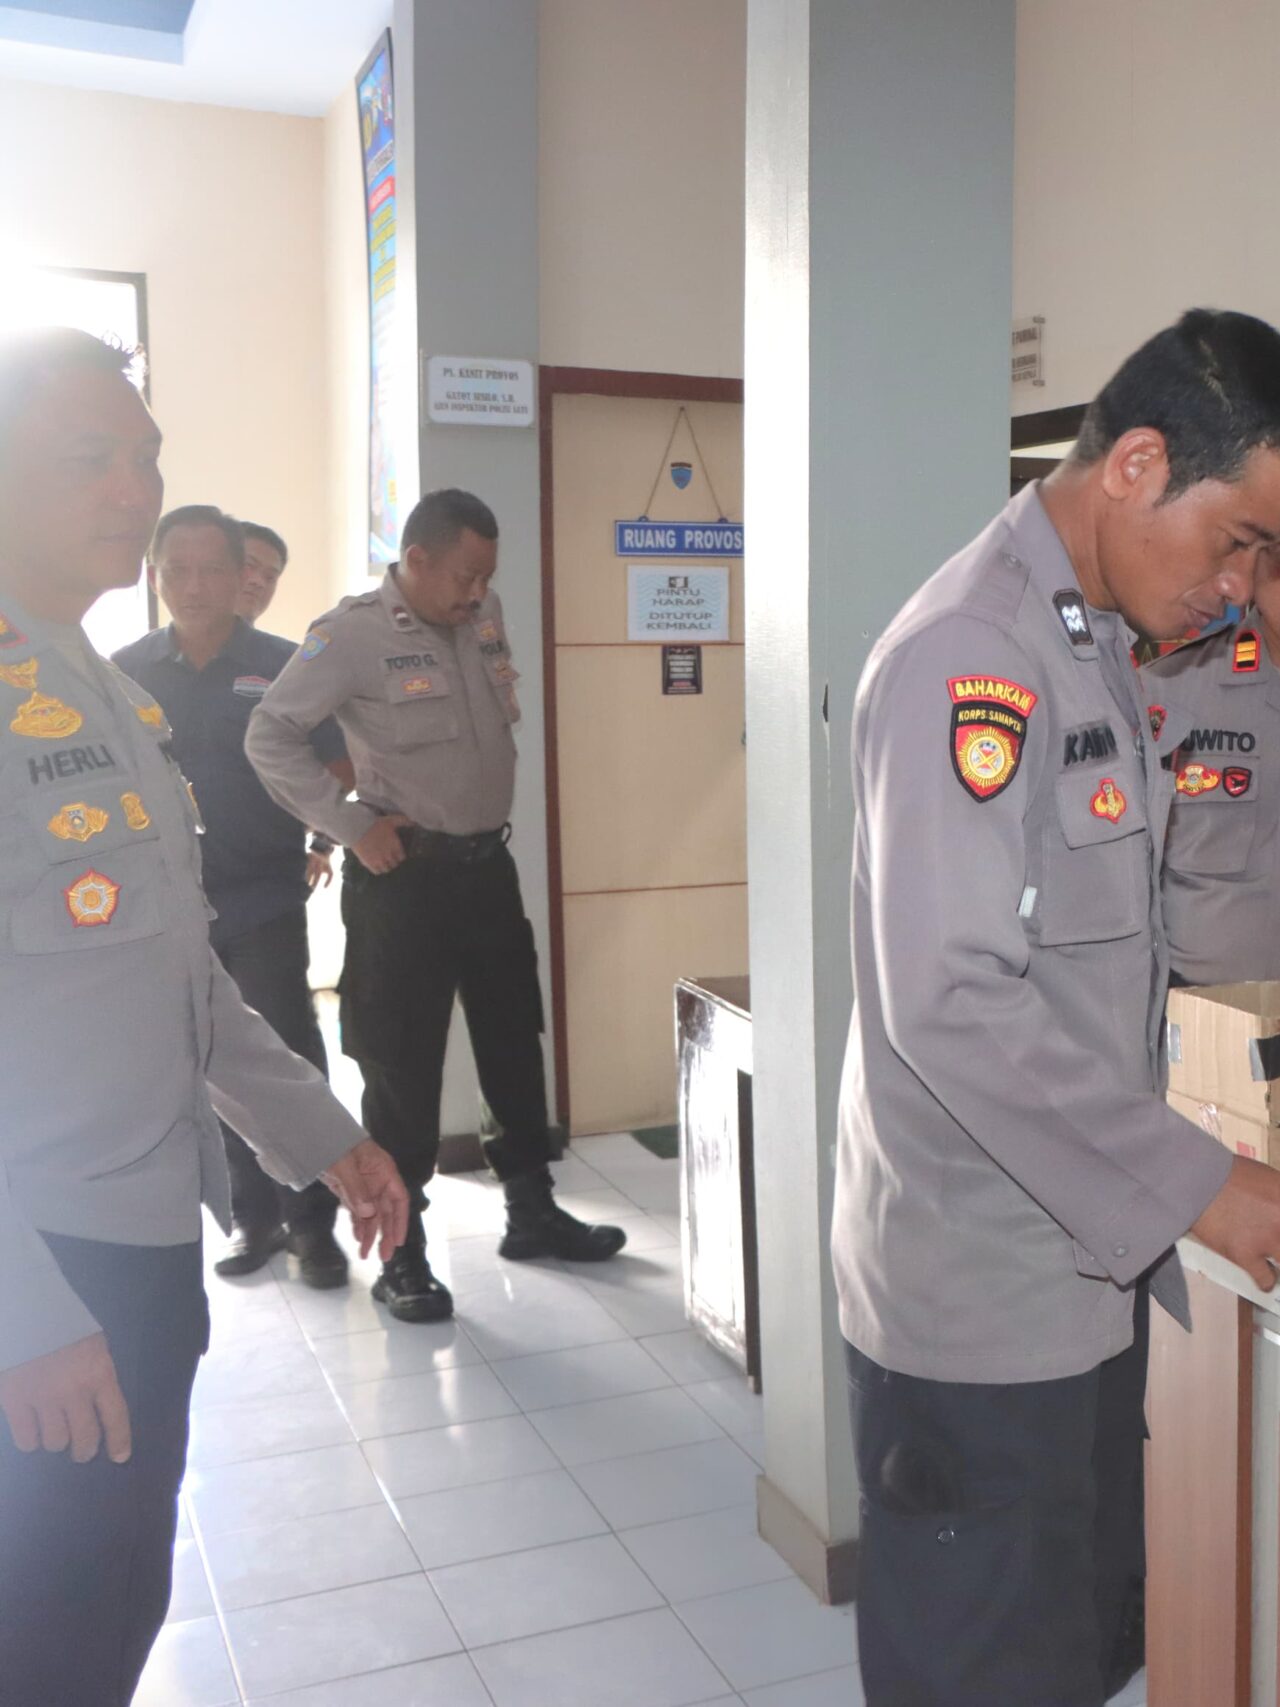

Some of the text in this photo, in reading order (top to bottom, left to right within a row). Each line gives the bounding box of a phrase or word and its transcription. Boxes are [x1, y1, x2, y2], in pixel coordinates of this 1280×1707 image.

[624, 528, 743, 549] RUANG PROVOS
[656, 588, 701, 596] PINTU
[652, 598, 705, 606] HARAP
[648, 612, 713, 620] DITUTUP
[646, 622, 711, 631] KEMBALI
[384, 655, 421, 671] TOTO
[954, 679, 1031, 712] BAHARKAM
[958, 708, 1022, 734] KORPS SAMAPTA
